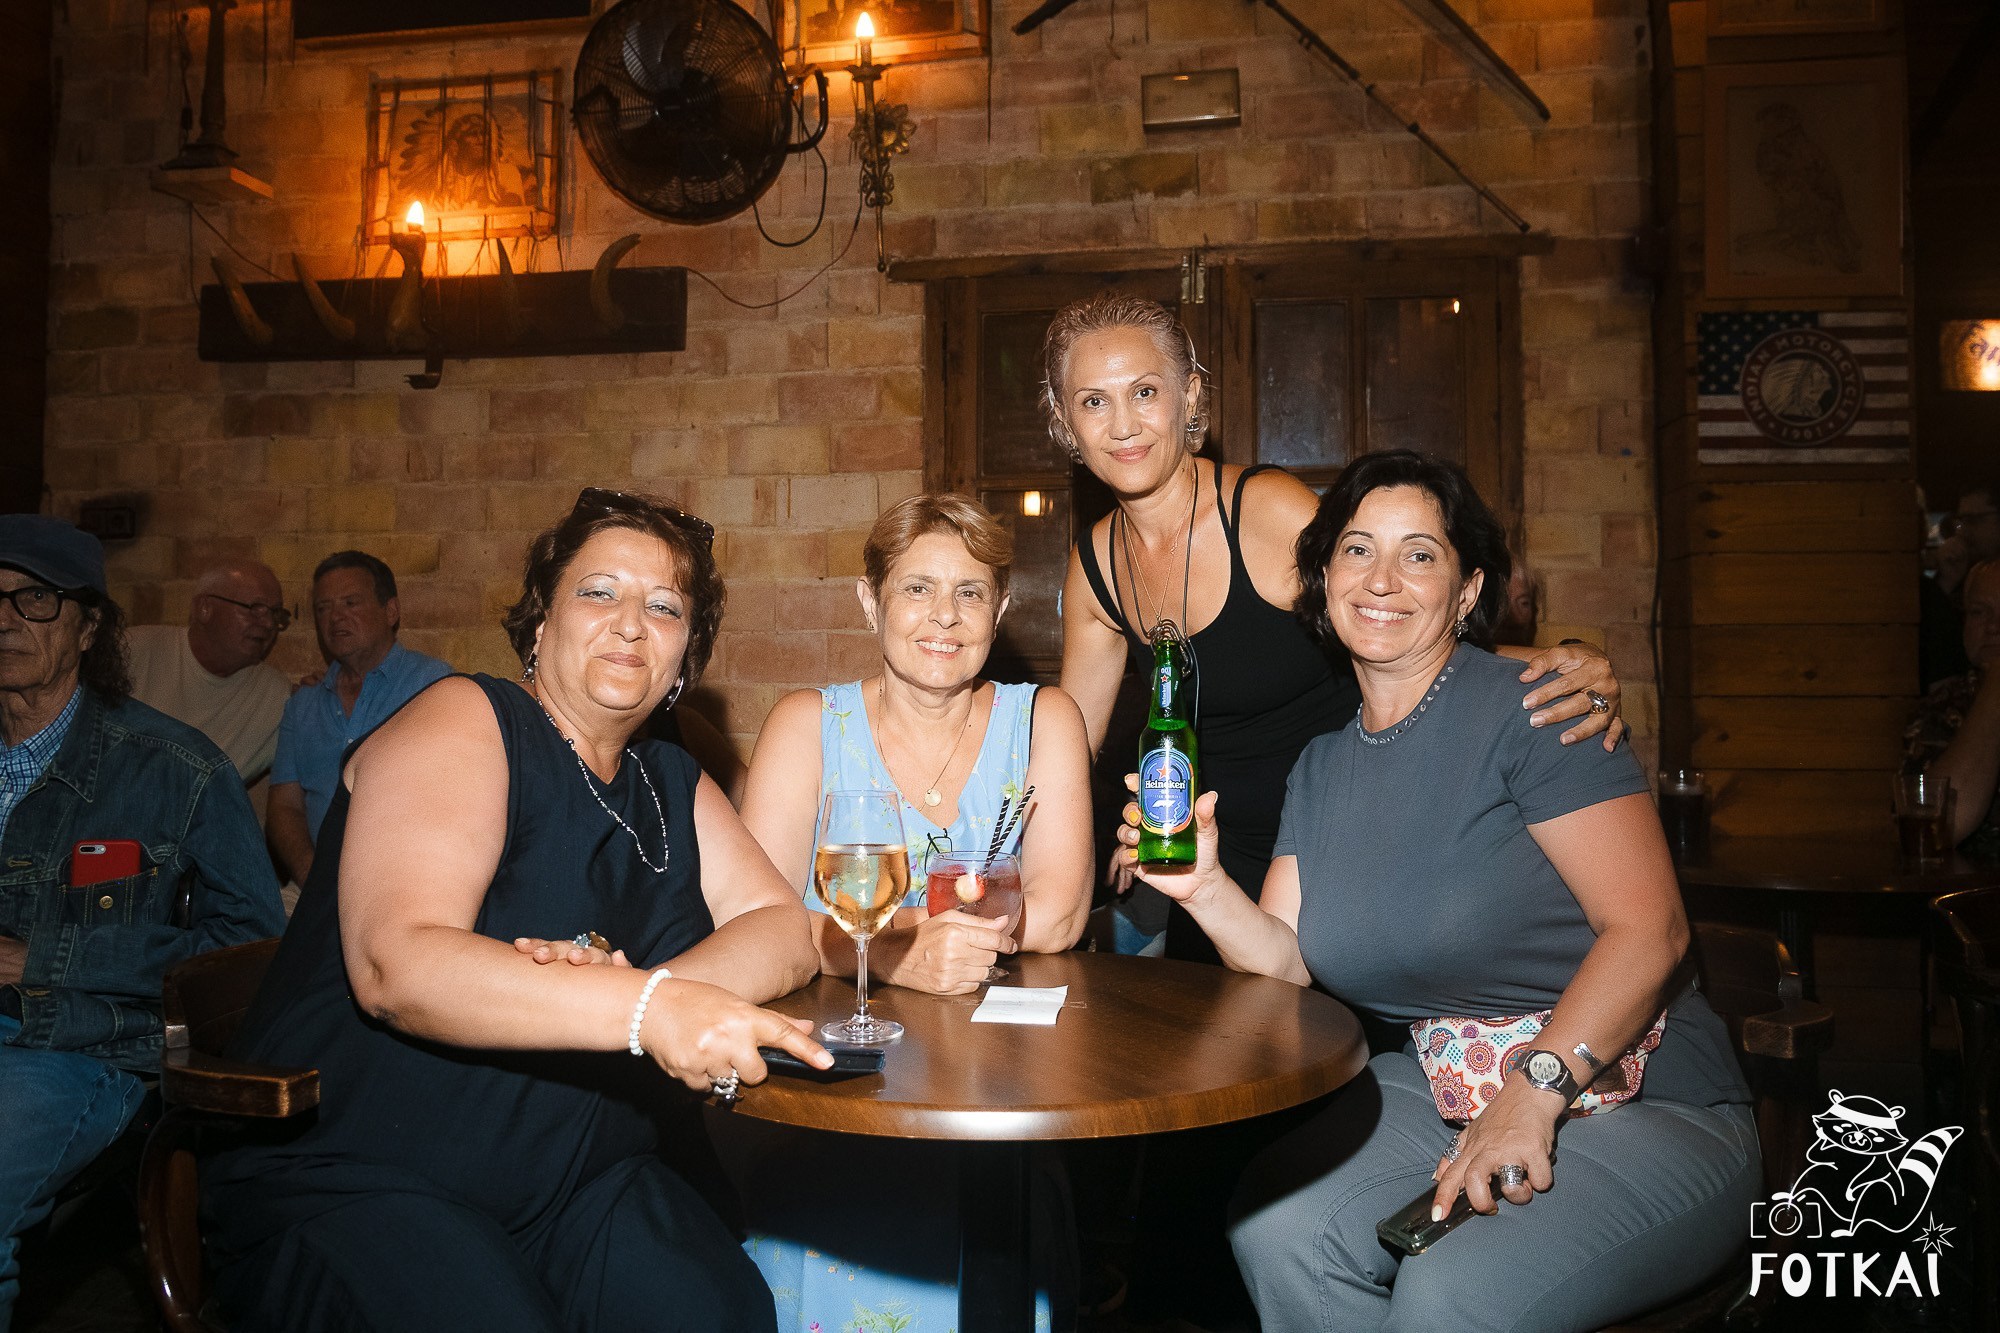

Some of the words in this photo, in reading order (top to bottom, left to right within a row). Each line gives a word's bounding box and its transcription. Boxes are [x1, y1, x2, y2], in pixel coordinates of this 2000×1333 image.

[1746, 351, 1772, 420] INDIAN
[1774, 335, 1858, 420] MOTORCYCLE
[1781, 426, 1825, 441] 1901
